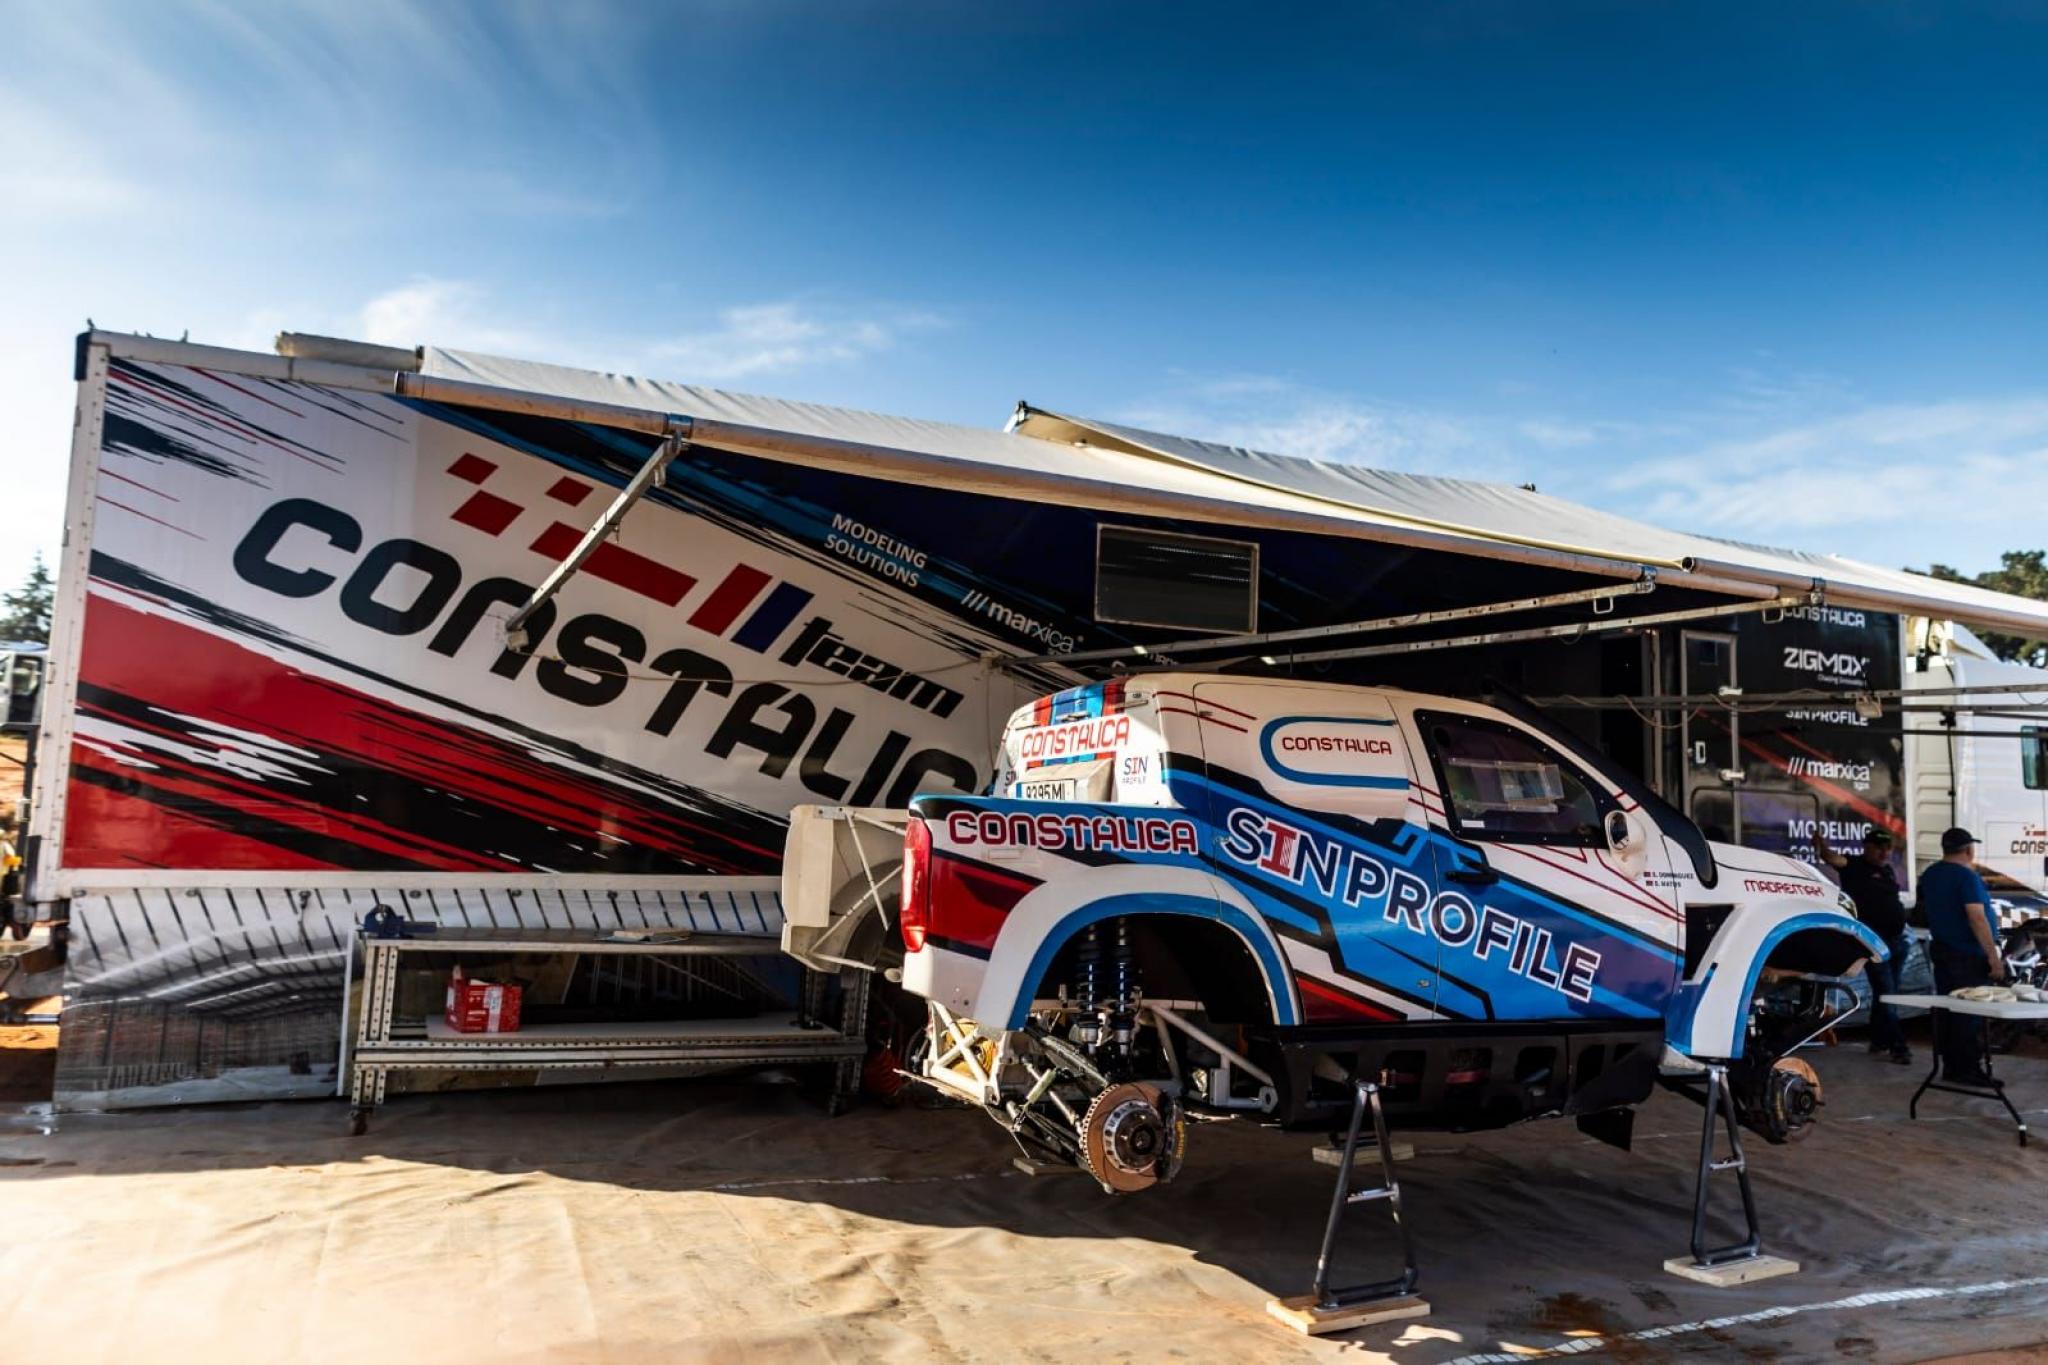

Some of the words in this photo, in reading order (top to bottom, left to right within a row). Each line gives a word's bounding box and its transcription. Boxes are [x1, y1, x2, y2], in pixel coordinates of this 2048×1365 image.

[824, 533, 920, 588] SOLUTIONS
[831, 513, 928, 569] MODELING
[233, 498, 977, 808] CONSTALIC
[779, 616, 964, 719] team
[1021, 717, 1130, 759] CONSTALICA
[1282, 737, 1392, 754] CONSTALICA
[1123, 756, 1149, 775] SIN
[946, 810, 1199, 856] CONSTALICA
